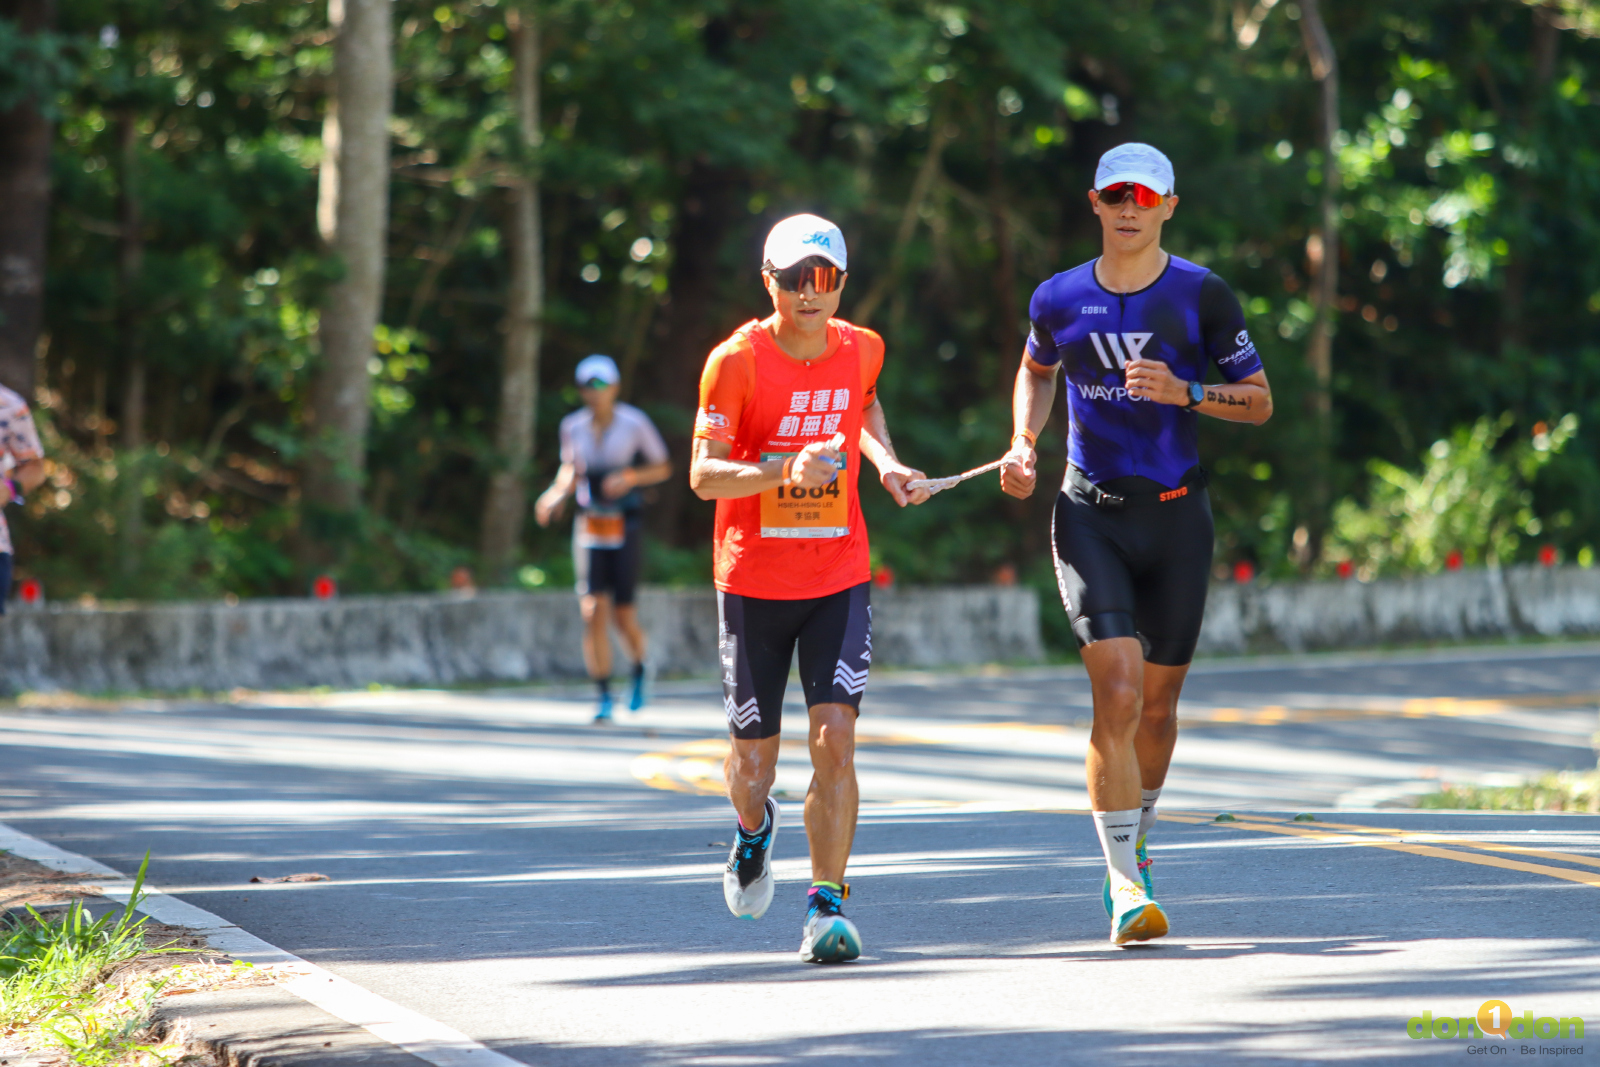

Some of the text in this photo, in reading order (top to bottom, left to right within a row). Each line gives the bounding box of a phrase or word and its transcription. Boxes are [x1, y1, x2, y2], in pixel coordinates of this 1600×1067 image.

[1081, 306, 1108, 315] GOBIK
[788, 388, 850, 413] 愛運動
[776, 413, 842, 437] 動無礙
[1159, 486, 1188, 502] STRYD
[778, 501, 822, 509] HSIEH-HSING
